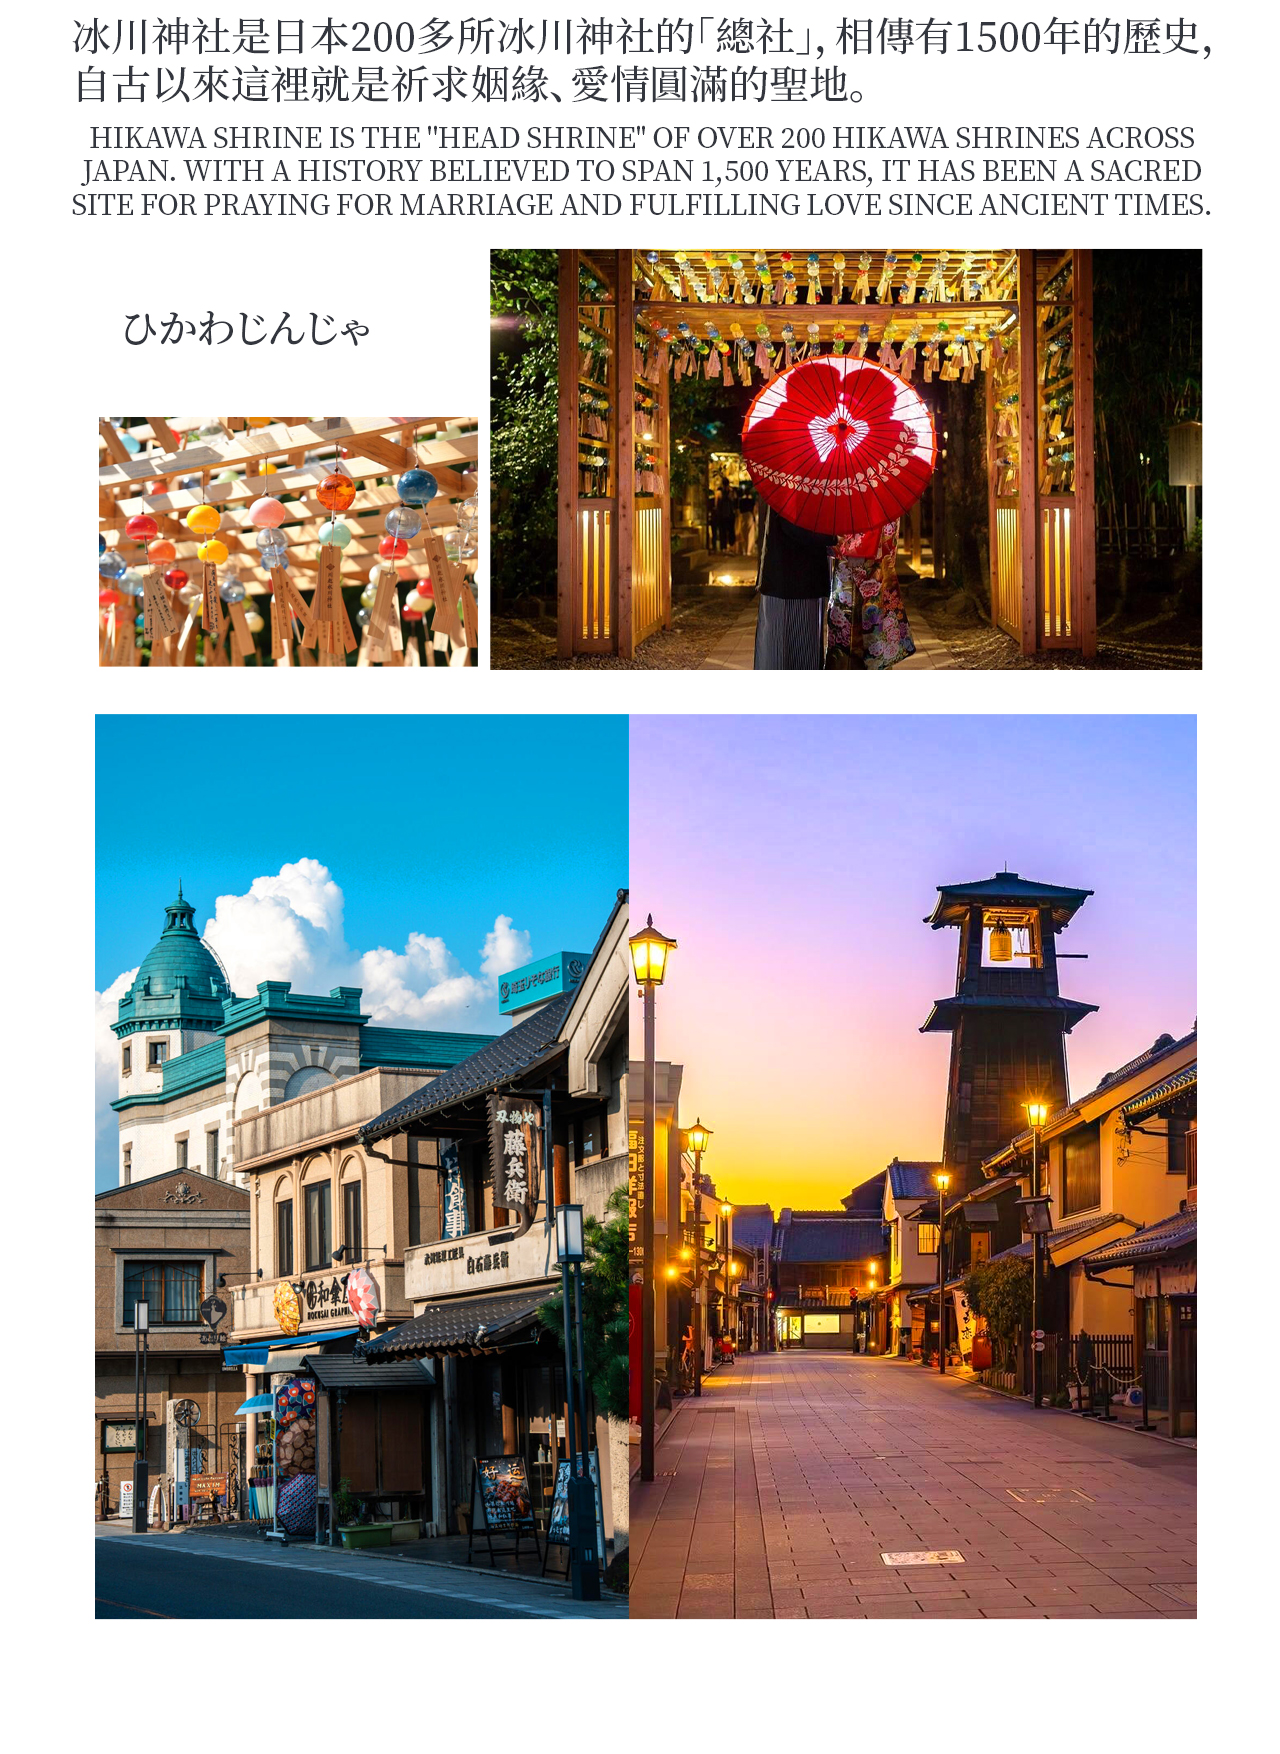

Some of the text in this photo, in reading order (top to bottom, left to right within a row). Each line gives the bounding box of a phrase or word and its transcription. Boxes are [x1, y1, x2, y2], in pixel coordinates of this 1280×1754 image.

[510, 965, 560, 994] 埼玉りそな銀行
[495, 1109, 535, 1126] 刃物や
[503, 1128, 529, 1205] 藤兵衛
[467, 1251, 509, 1275] 白石藤兵衛
[307, 1309, 329, 1320] HOKUSAI
